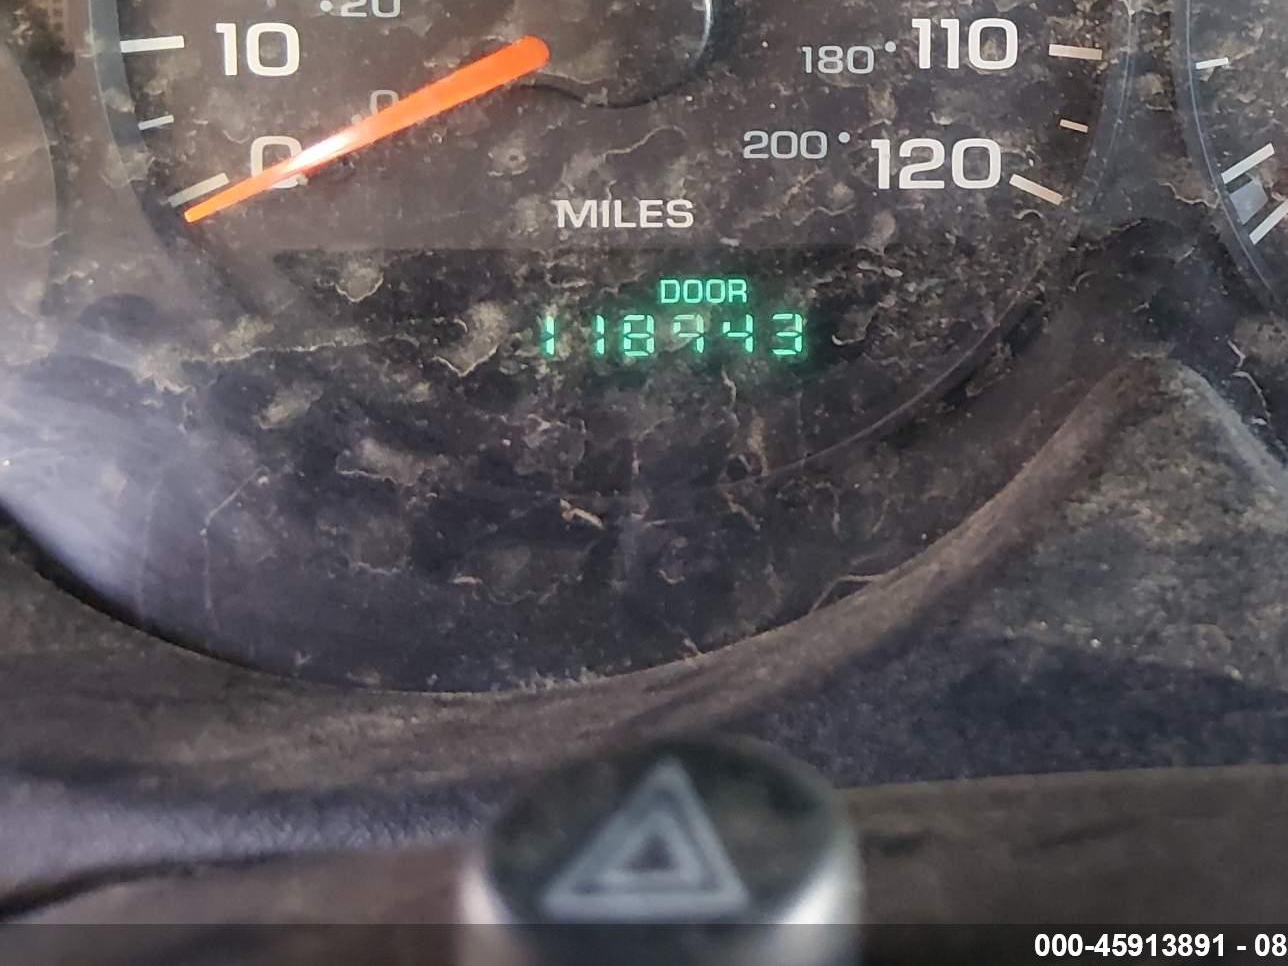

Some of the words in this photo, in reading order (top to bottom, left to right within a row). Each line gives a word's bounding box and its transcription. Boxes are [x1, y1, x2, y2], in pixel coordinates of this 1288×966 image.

[216, 23, 299, 76] 10
[803, 46, 876, 73] 180
[912, 18, 1017, 69] 110
[250, 136, 302, 188] 0
[744, 131, 827, 158] 200
[871, 139, 1001, 189] 120
[556, 199, 694, 228] MILES
[661, 280, 746, 303] DOOR
[545, 312, 802, 357] 118943
